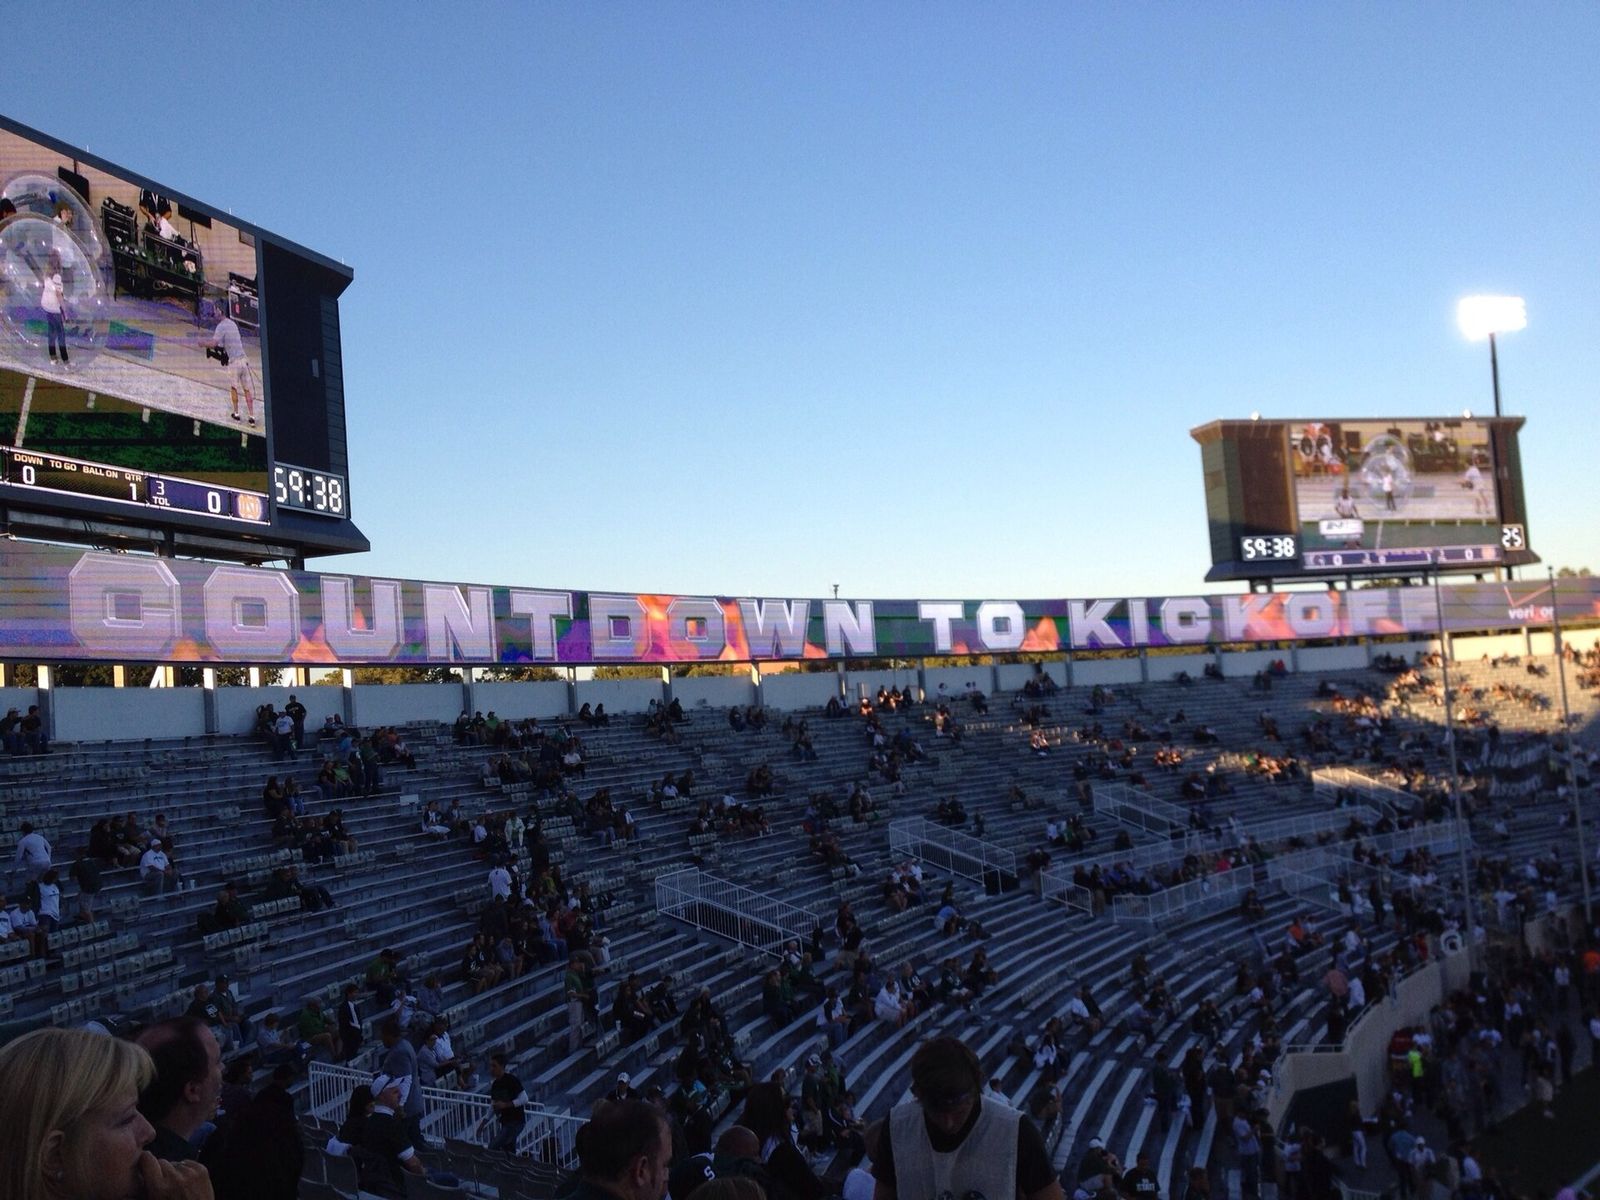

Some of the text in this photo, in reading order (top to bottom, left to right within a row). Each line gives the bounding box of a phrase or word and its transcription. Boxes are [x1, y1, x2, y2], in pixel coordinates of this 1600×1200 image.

[14, 453, 142, 482] DOWN TO GO BALL ON QTR
[22, 465, 35, 485] 0
[129, 482, 137, 501] 1
[155, 480, 165, 496] 3
[274, 467, 342, 513] 59:38
[152, 495, 170, 507] TOL
[207, 491, 221, 514] 0
[1242, 537, 1296, 559] 59:38
[1501, 527, 1522, 548] 25
[68, 552, 1443, 662] COUNTDOWN TO KICKOFF
